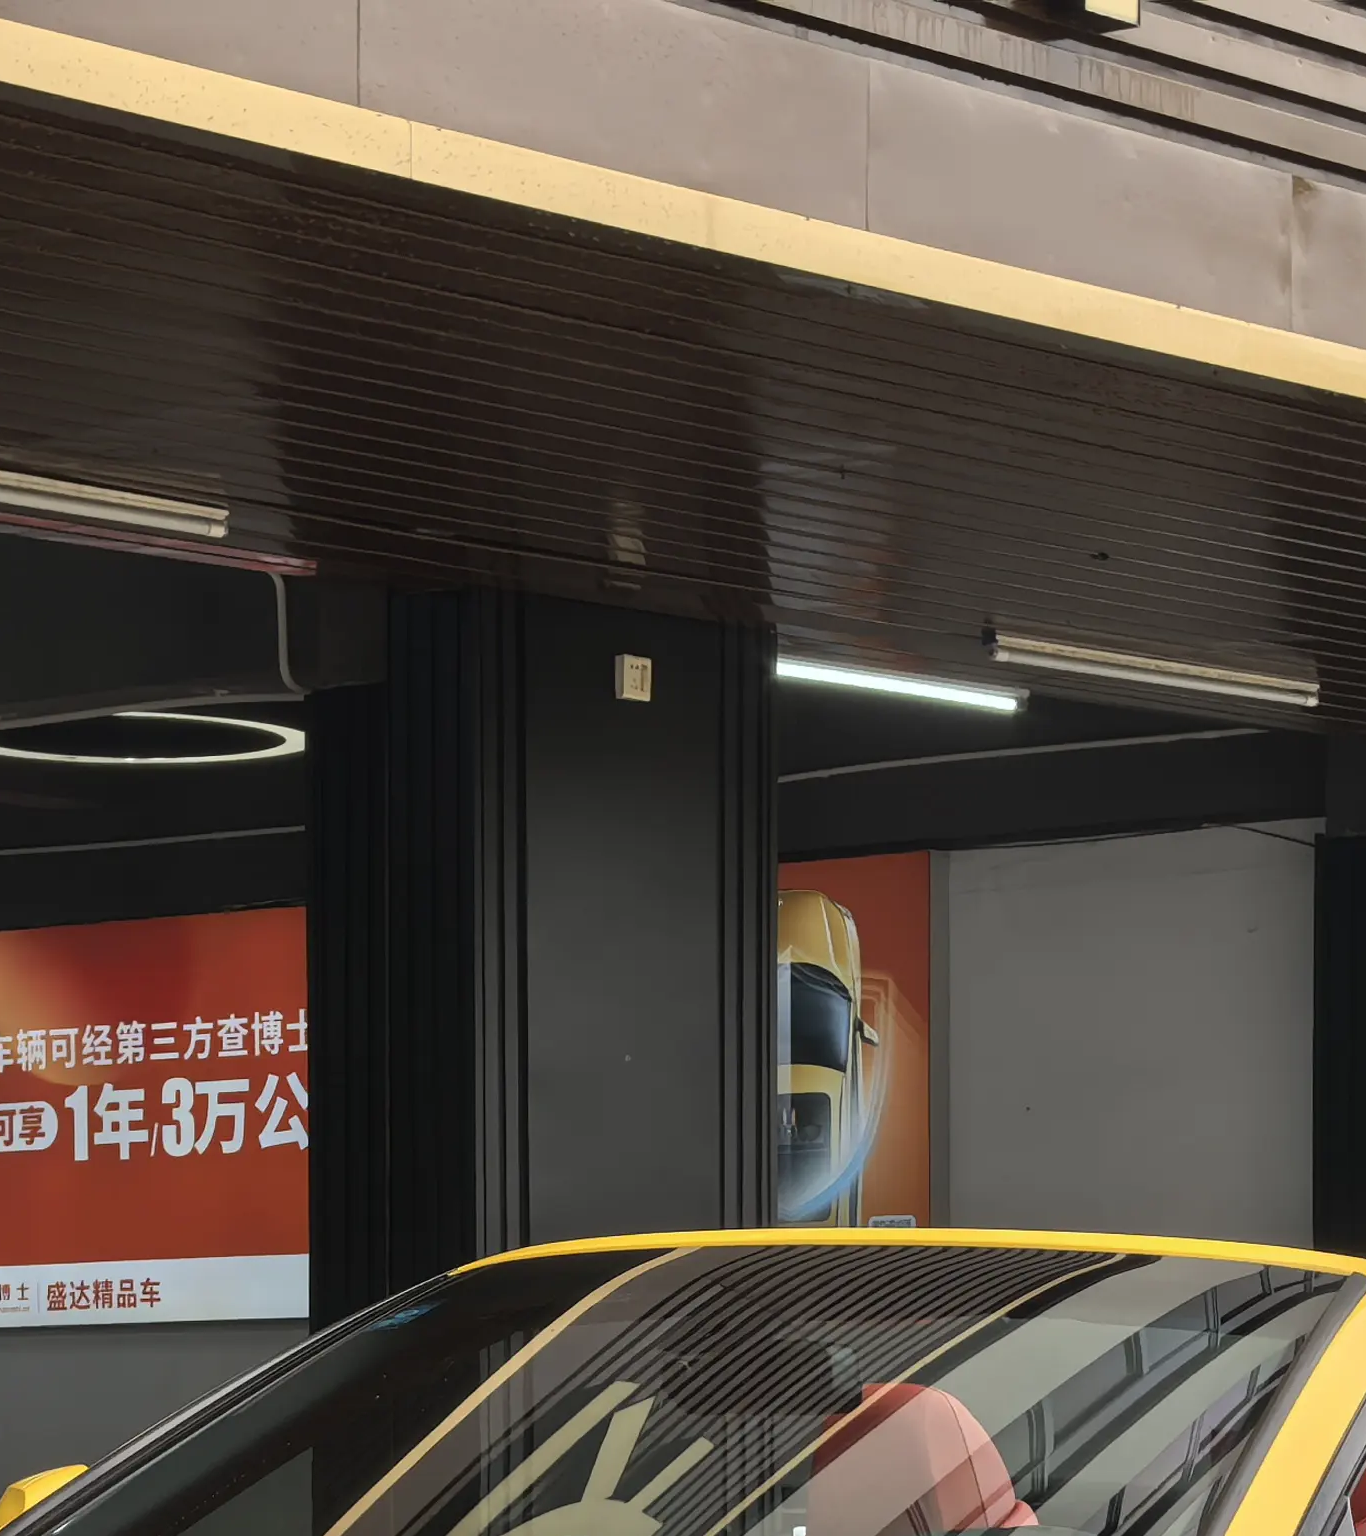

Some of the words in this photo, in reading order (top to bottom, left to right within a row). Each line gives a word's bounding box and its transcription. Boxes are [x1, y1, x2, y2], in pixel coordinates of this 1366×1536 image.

[46, 1277, 162, 1312] 盛达精品车
